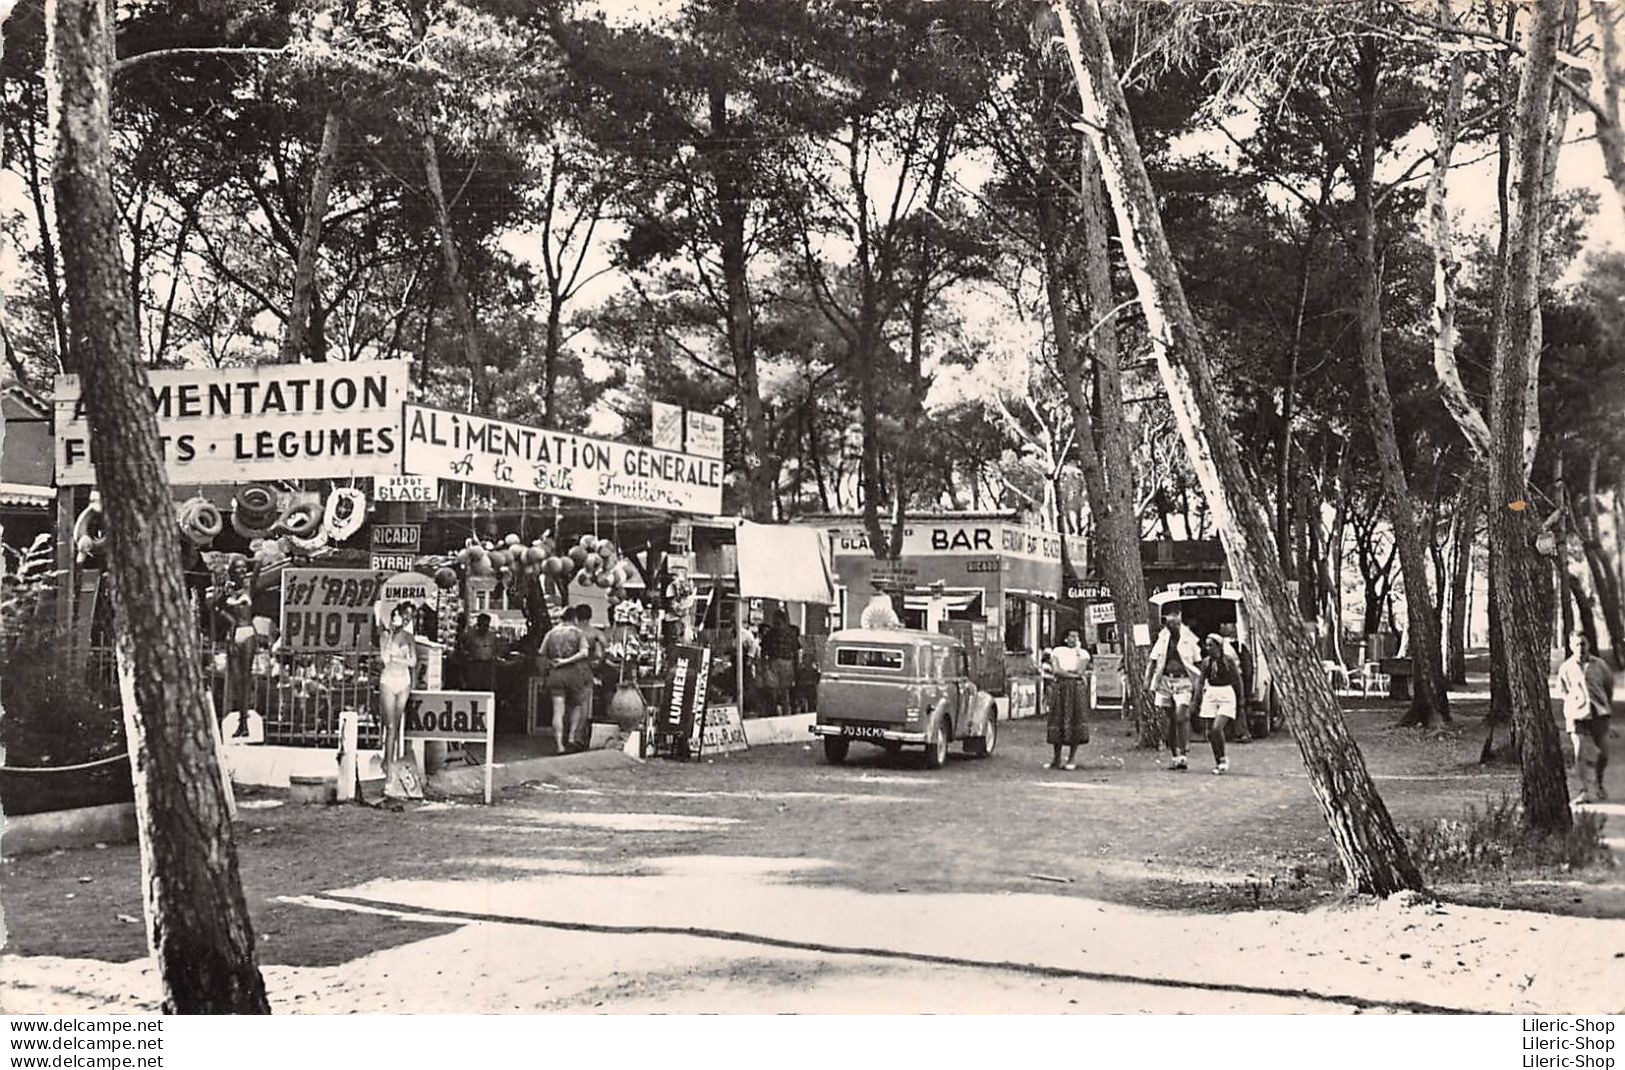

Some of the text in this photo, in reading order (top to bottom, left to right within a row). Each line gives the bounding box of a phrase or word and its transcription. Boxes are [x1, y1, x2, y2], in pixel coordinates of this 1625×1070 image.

[74, 376, 387, 420] AMENTATION
[65, 434, 196, 465] FTS
[378, 486, 432, 500] GLACE
[373, 527, 417, 544] RICARD
[931, 528, 994, 550] BAR
[372, 556, 412, 571] BYRRH
[385, 587, 426, 599] UMBRIA
[404, 700, 487, 732] Kodak
